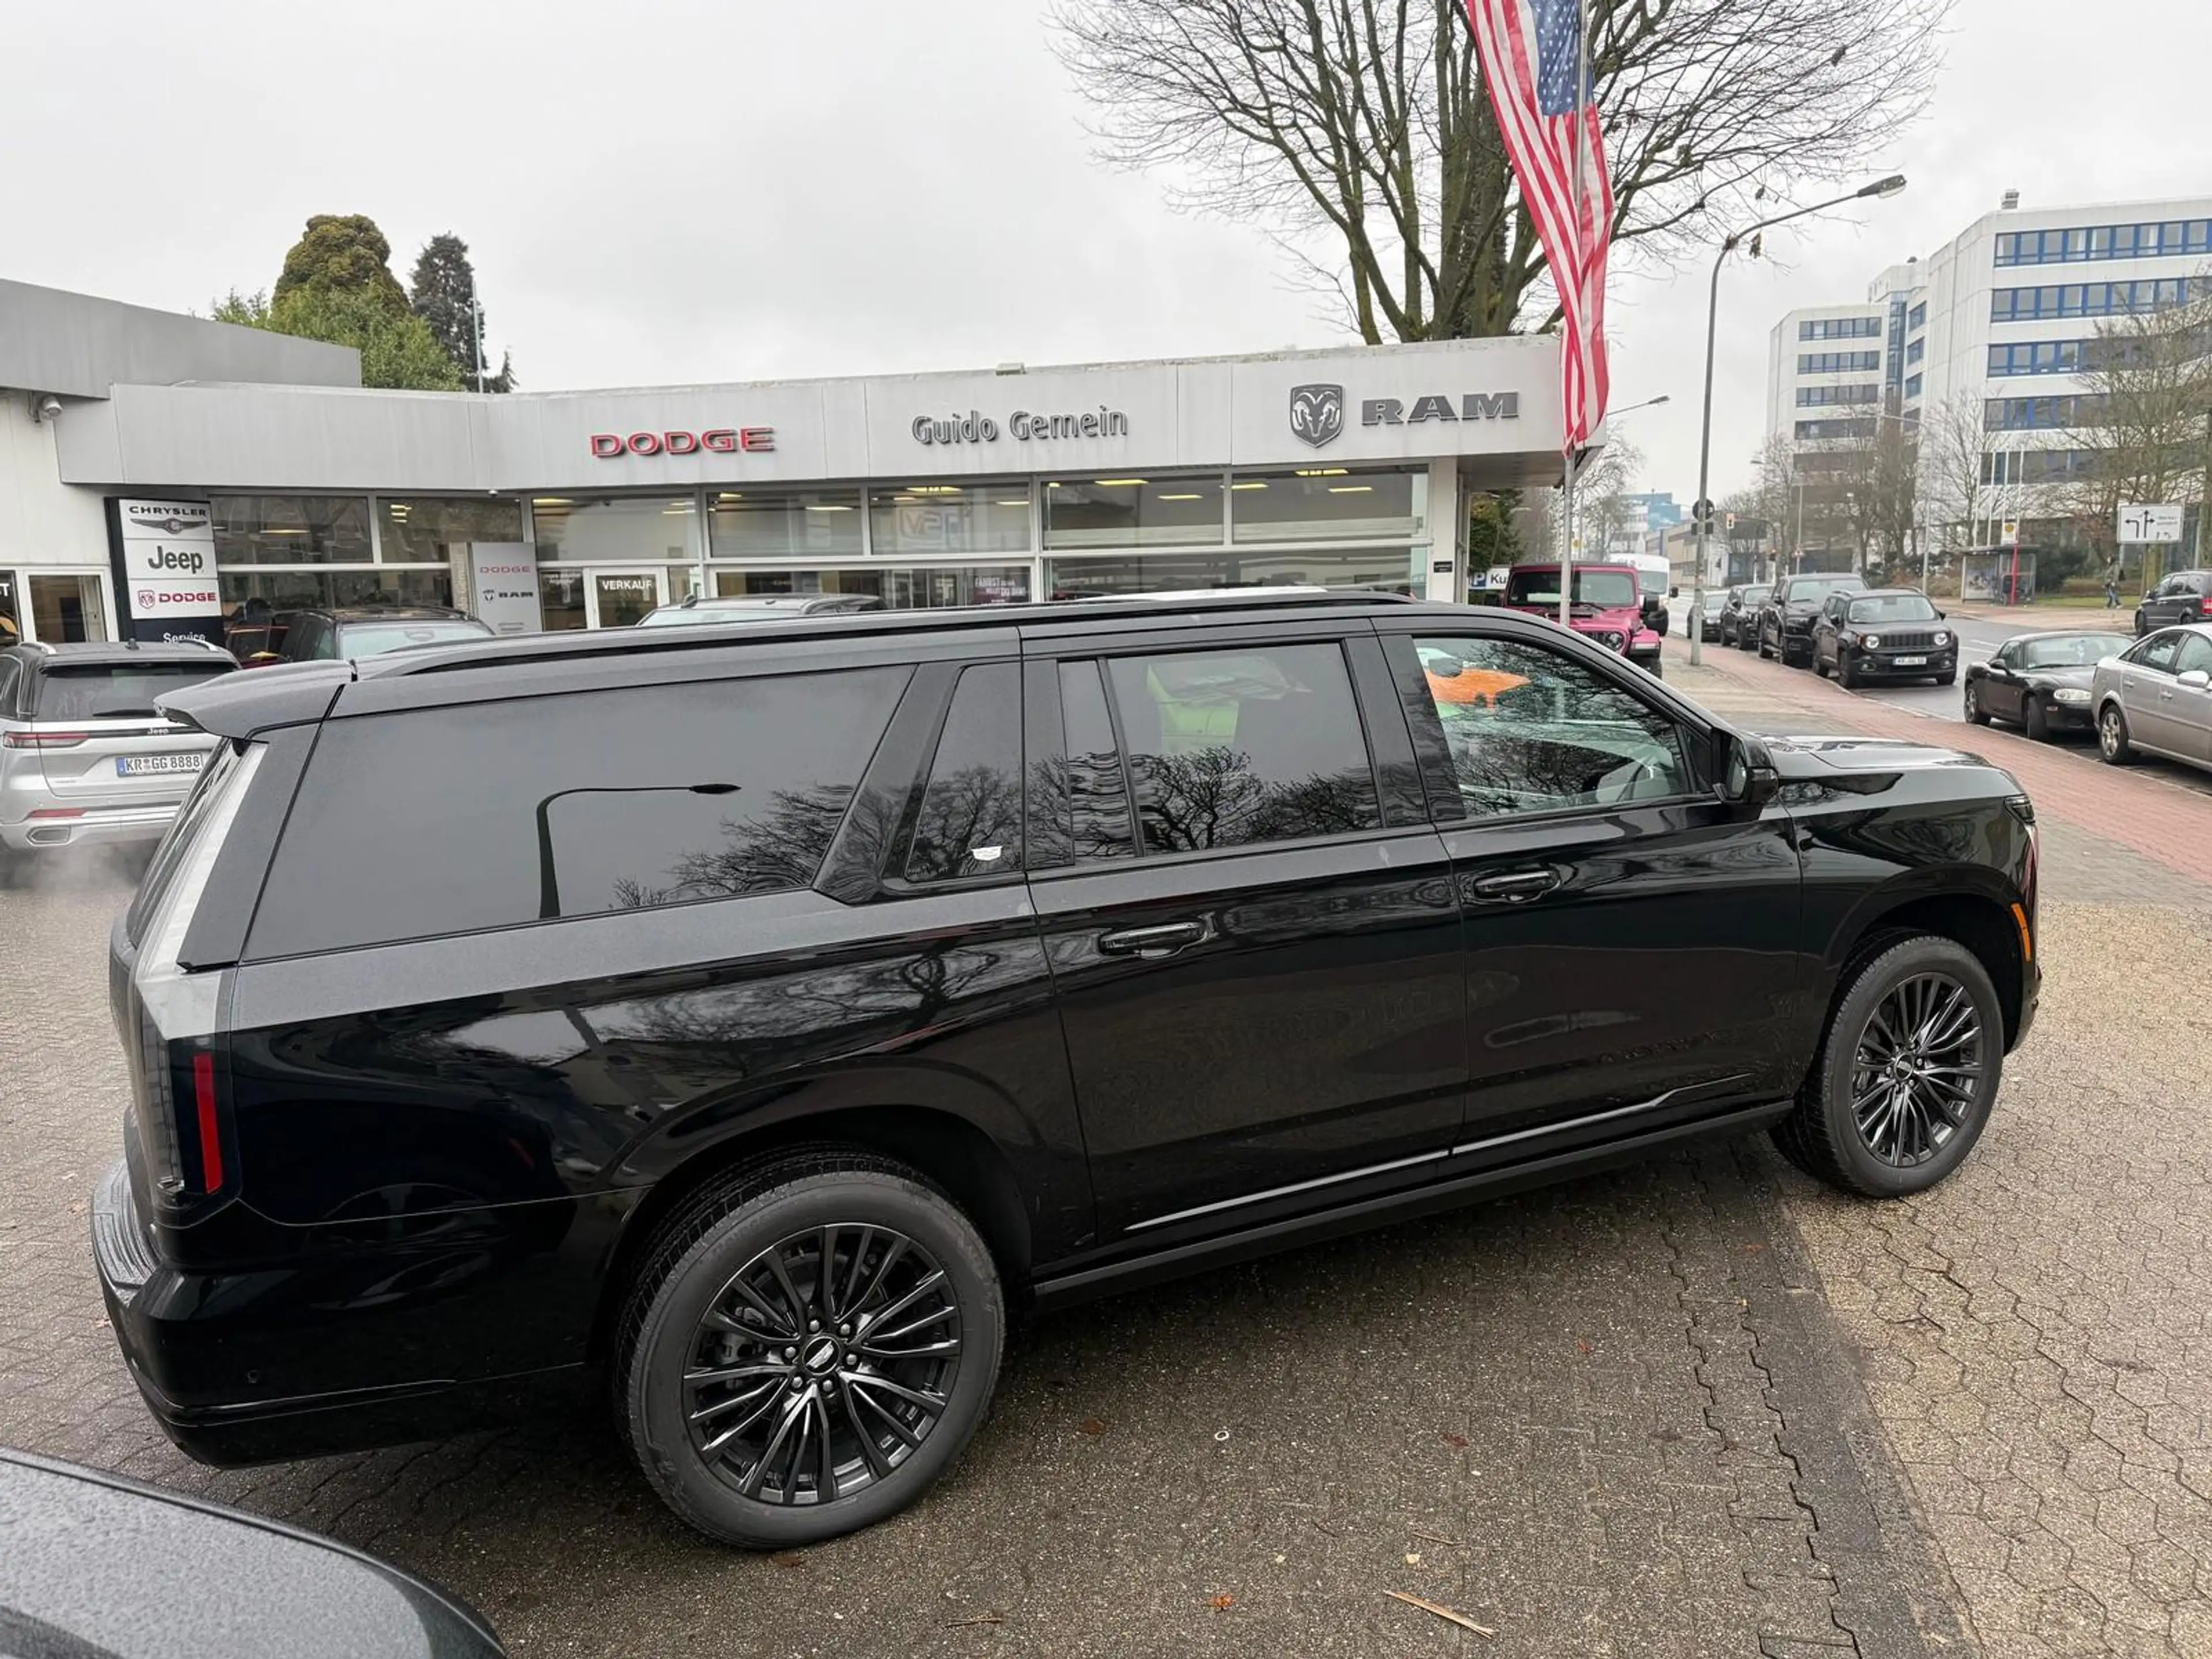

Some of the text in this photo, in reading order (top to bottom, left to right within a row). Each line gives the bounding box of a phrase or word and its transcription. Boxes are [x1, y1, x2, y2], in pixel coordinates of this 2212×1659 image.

[1362, 391, 1518, 425] RAM
[912, 404, 1128, 445] Guido Gemein
[589, 427, 775, 457] DODGE
[128, 505, 206, 516] CHRYSLER
[147, 546, 203, 574] Jeep
[480, 565, 531, 573] DODGE
[602, 578, 652, 590] VERKAUF
[158, 592, 217, 603] DODGE
[147, 727, 169, 735] Jeep
[126, 755, 200, 771] KR GG 8888
